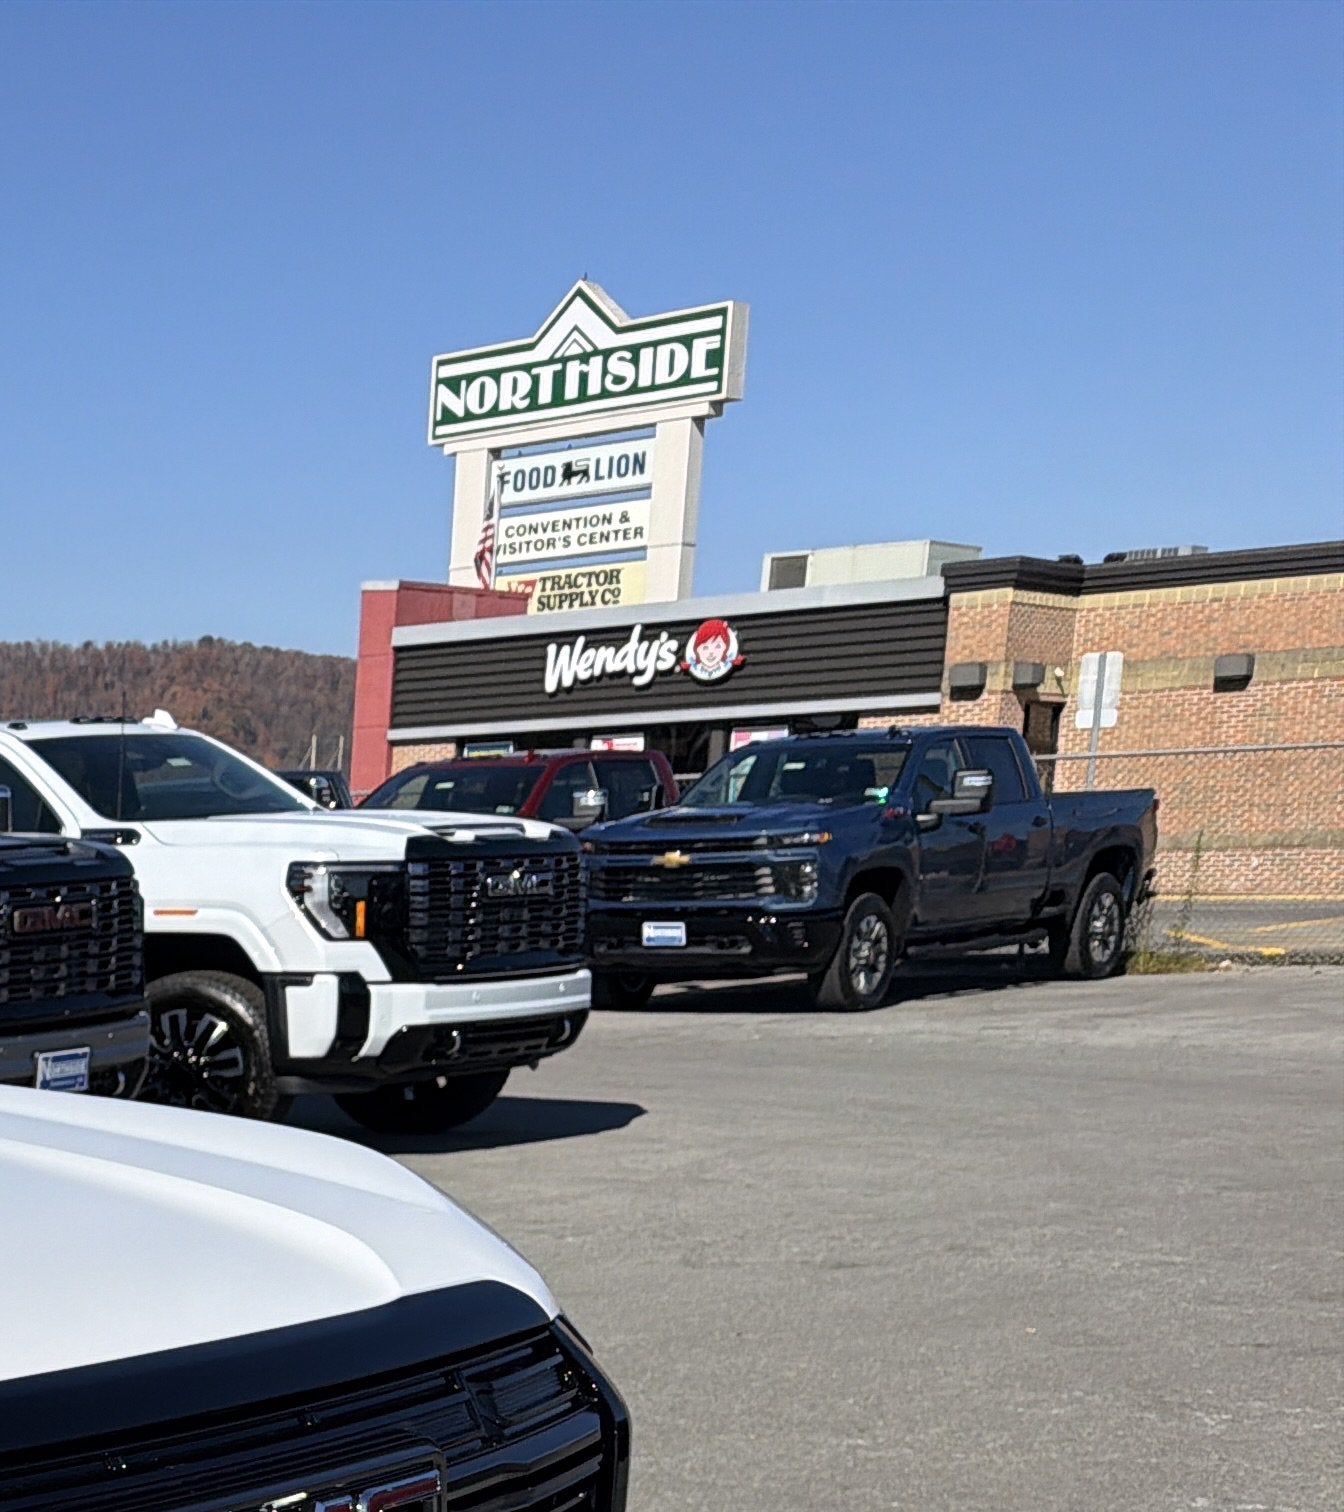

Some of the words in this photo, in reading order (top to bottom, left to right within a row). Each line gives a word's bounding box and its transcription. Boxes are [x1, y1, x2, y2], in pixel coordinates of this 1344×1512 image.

[436, 334, 722, 422] NORTHSIDE
[499, 463, 557, 495] FOOD
[595, 451, 647, 480] LION
[505, 511, 613, 539] CONVENTION
[619, 510, 631, 524] &
[577, 526, 644, 546] CENTER
[538, 568, 622, 592] TRACTOR
[537, 589, 598, 612] SUPPLY
[544, 624, 678, 694] Wendy's
[13, 901, 97, 934] GMC
